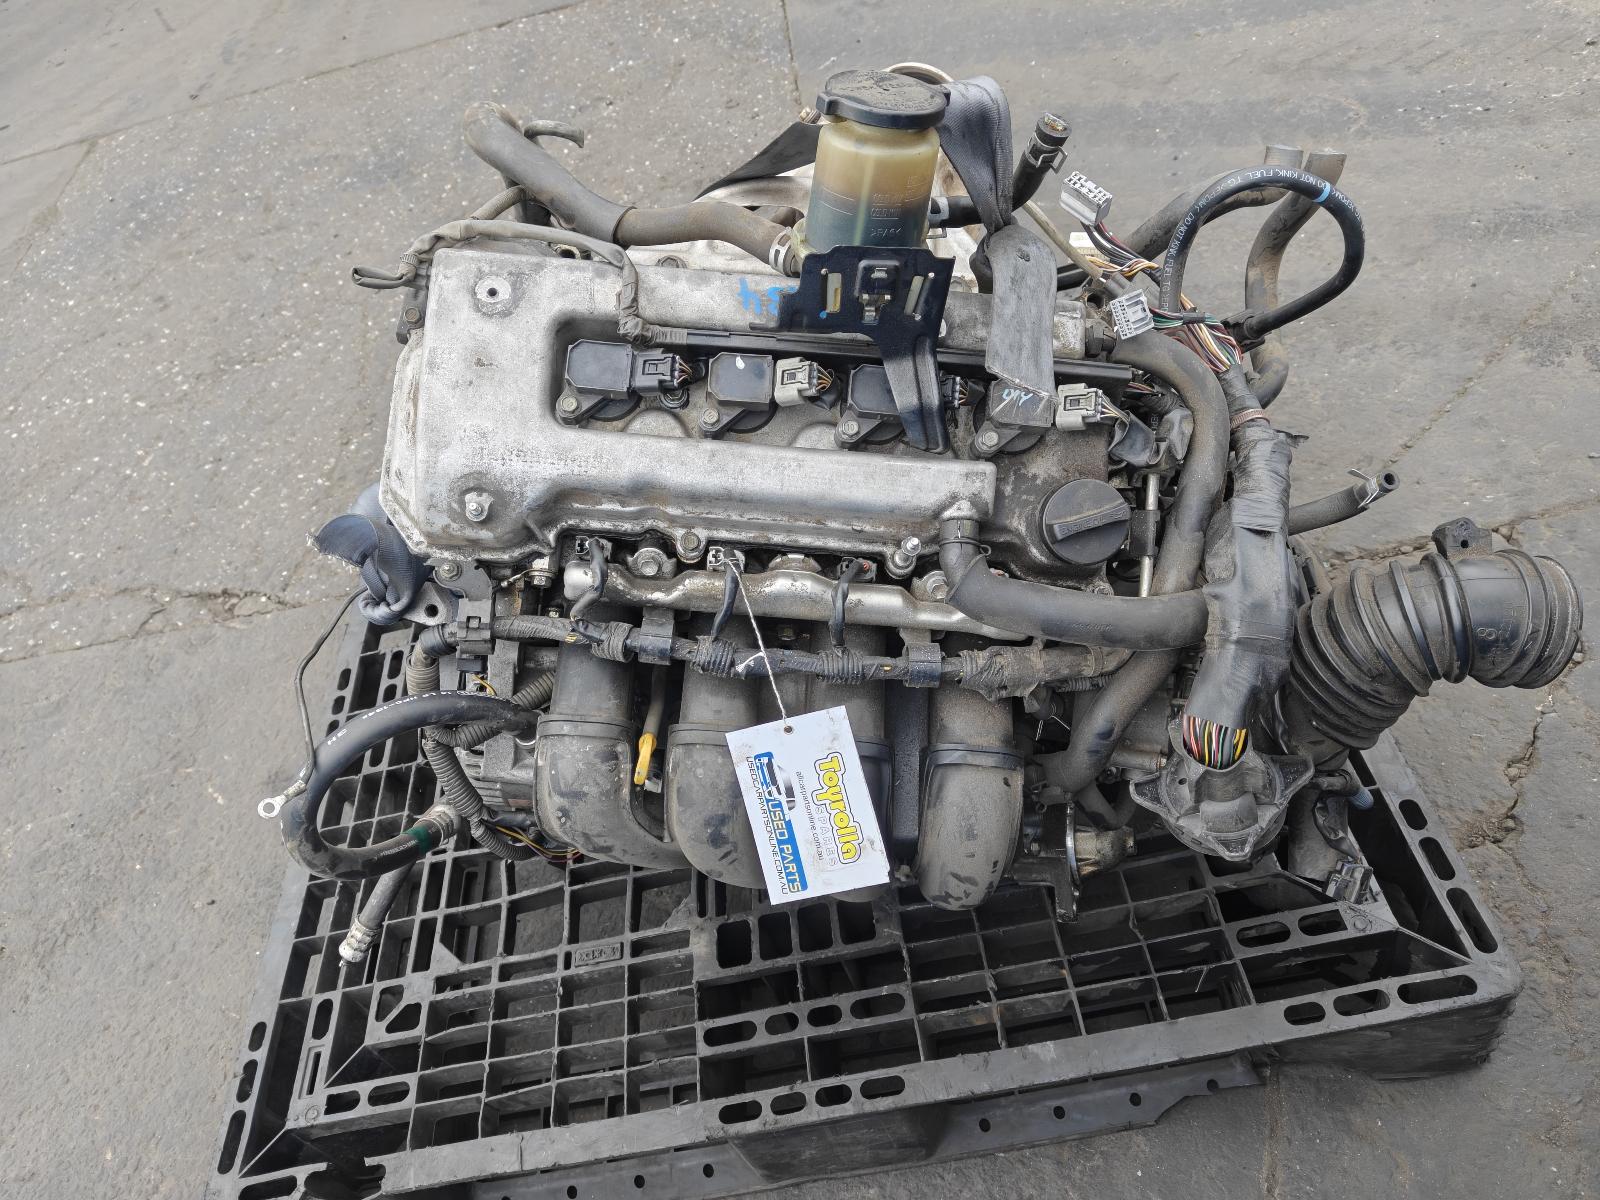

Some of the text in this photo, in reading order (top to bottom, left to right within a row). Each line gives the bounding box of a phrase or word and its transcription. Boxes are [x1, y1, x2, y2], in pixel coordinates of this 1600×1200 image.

[1227, 176, 1241, 187] TG
[1245, 169, 1273, 179] FUEL
[1300, 173, 1316, 186] NOT
[1184, 213, 1196, 226] DO
[1177, 224, 1188, 240] NOT
[1163, 260, 1175, 279] FUEL
[1163, 281, 1171, 292] TG
[795, 771, 824, 861] allcarpartsonline.com.au
[815, 755, 860, 861] Toyrolla
[746, 756, 789, 895] USEDCARPARTSONLINE.COM.AU
[815, 806, 838, 868] SPARES
[768, 800, 801, 893] USED PARTS
